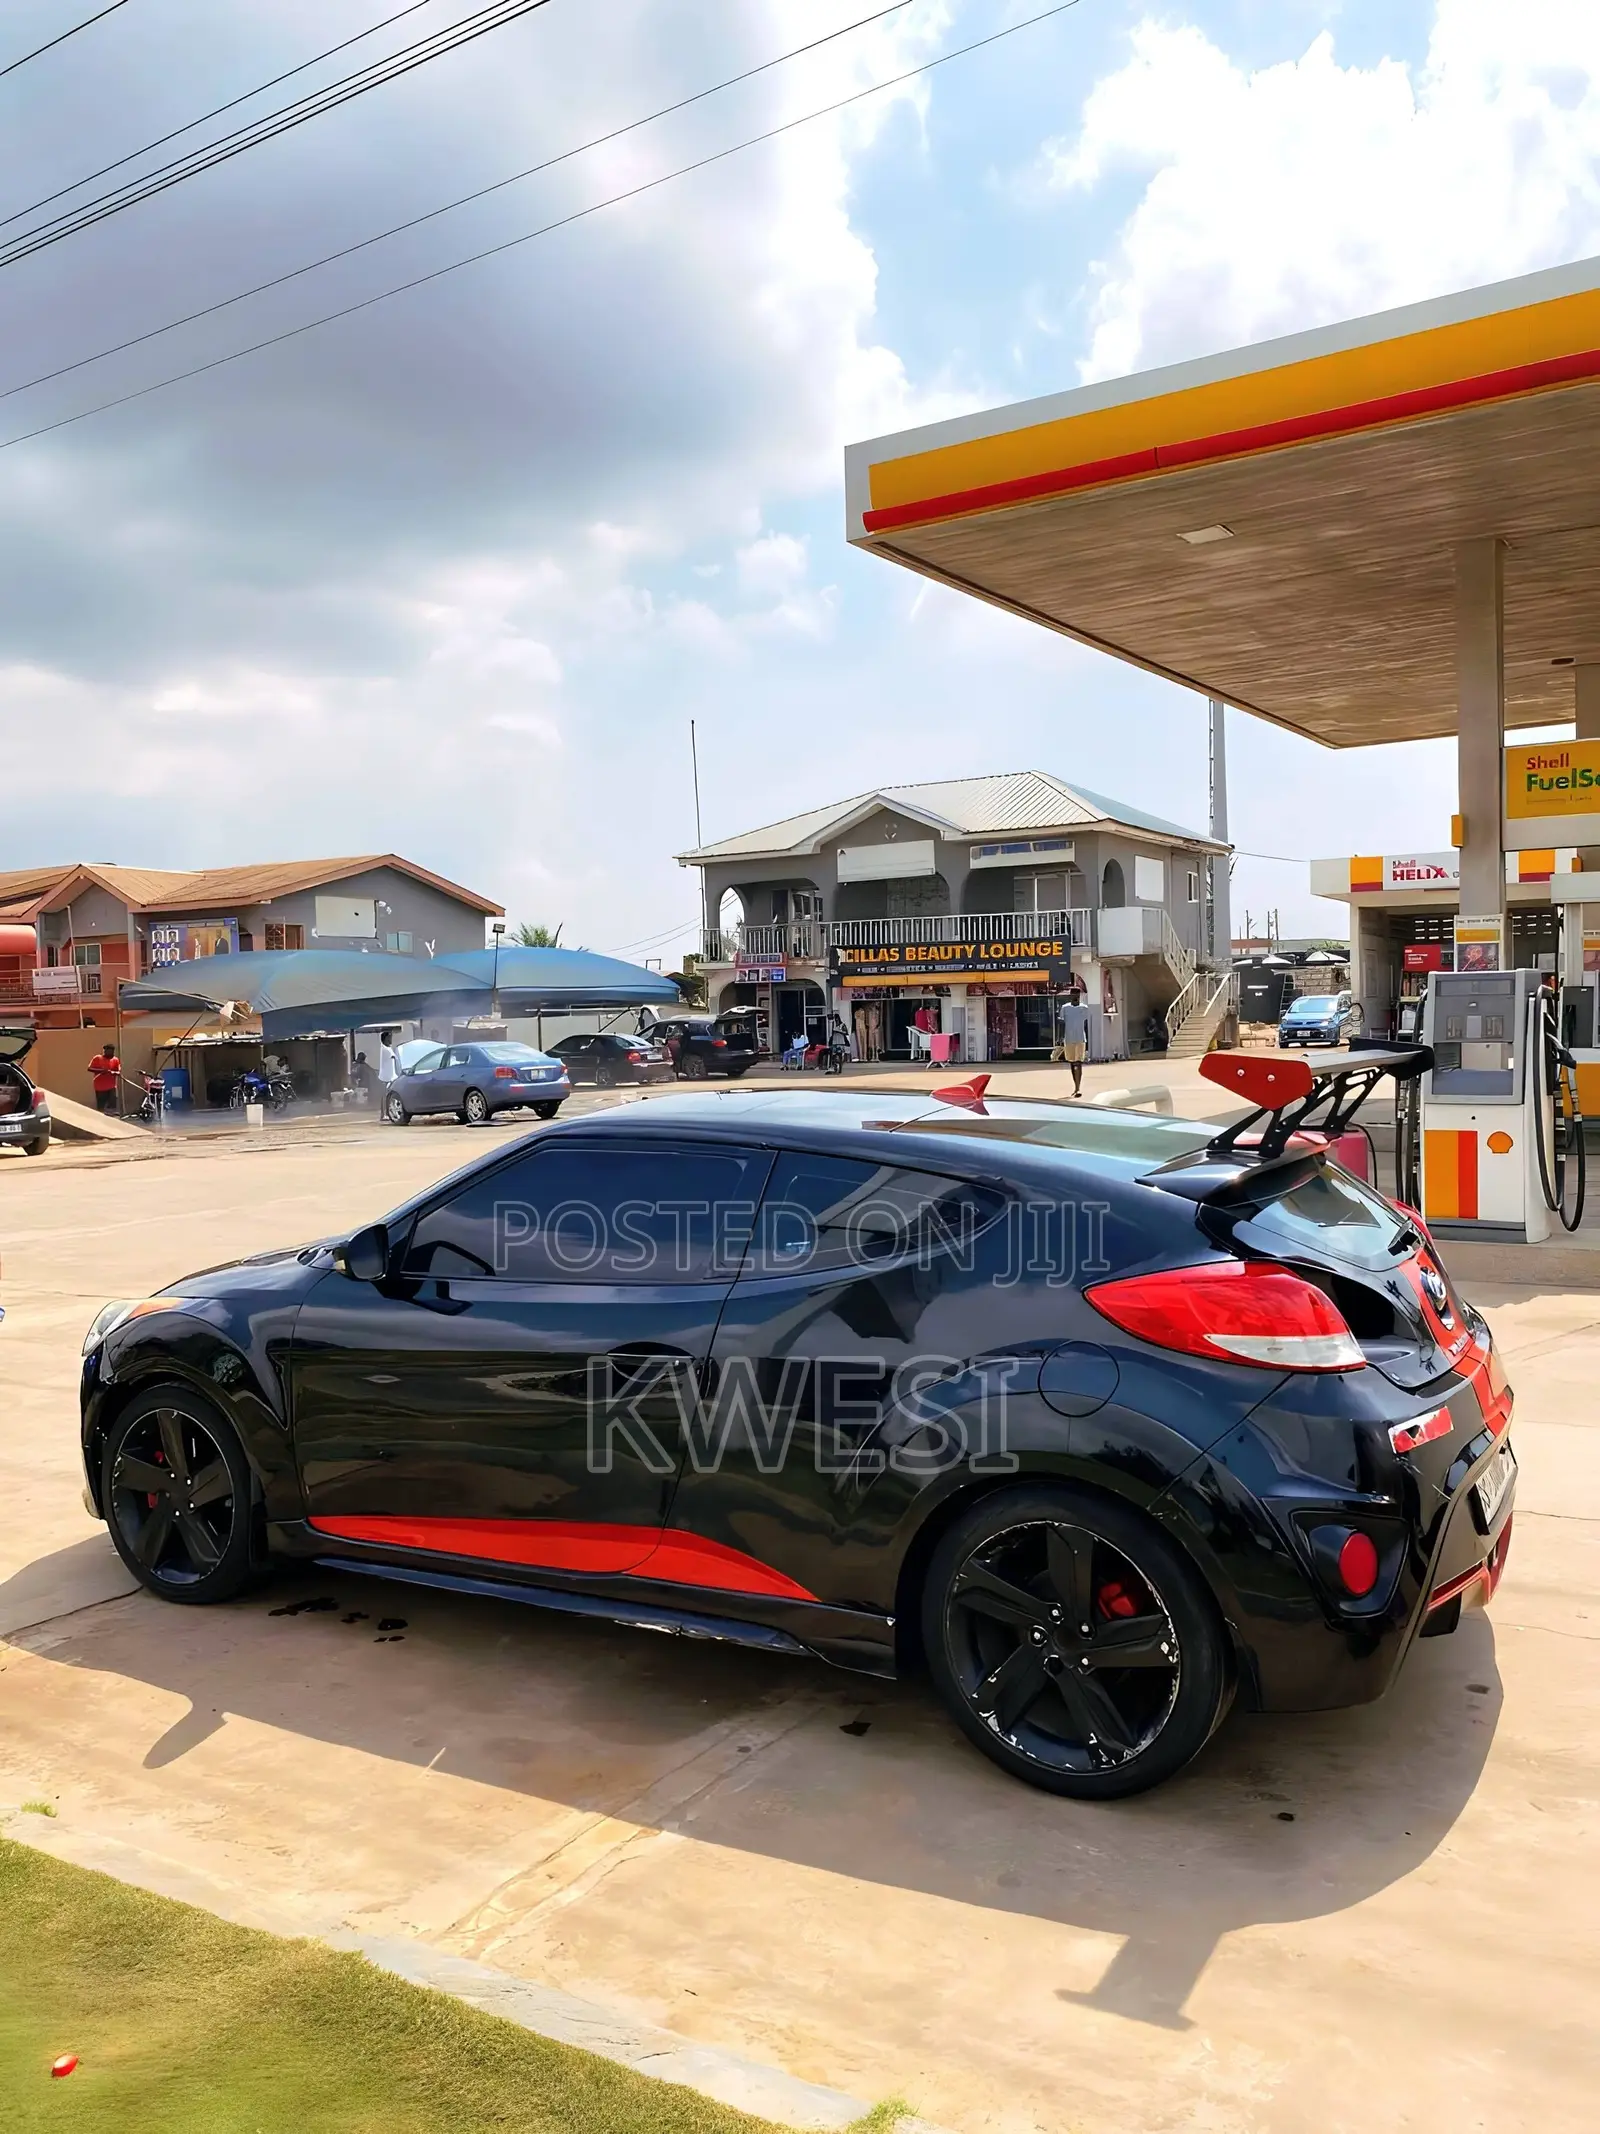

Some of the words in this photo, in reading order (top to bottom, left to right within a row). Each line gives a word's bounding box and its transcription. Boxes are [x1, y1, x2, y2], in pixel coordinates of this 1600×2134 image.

[1526, 753, 1570, 770] Shell
[1392, 866, 1448, 881] HELIX
[905, 945, 976, 961] BEAUTY
[980, 942, 1063, 959] LOUNGE
